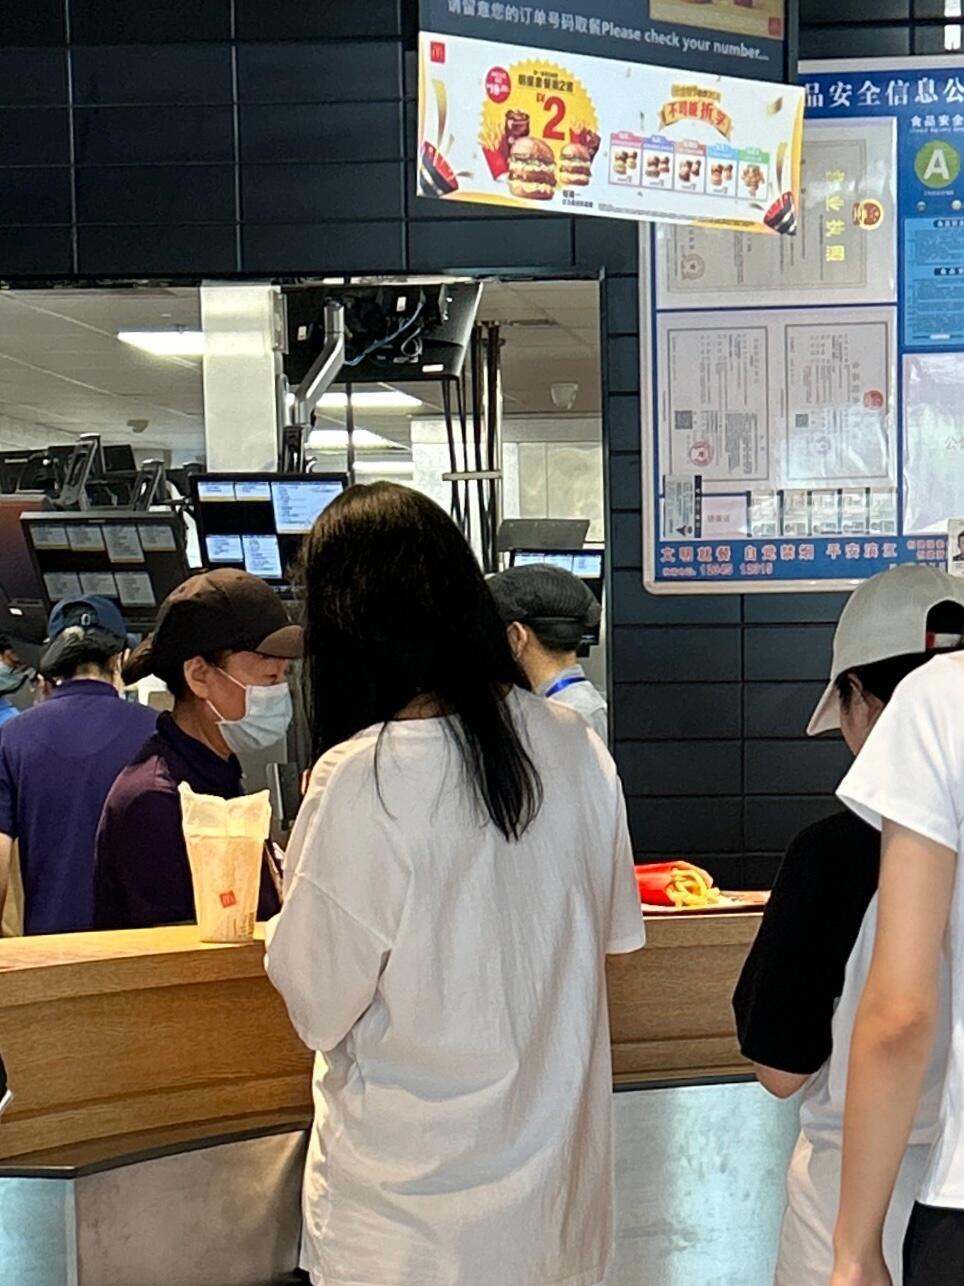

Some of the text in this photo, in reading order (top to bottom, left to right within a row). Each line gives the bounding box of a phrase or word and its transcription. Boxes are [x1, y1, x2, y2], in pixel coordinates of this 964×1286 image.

[644, 27, 681, 47] check
[682, 36, 711, 52] your
[923, 149, 951, 181] A
